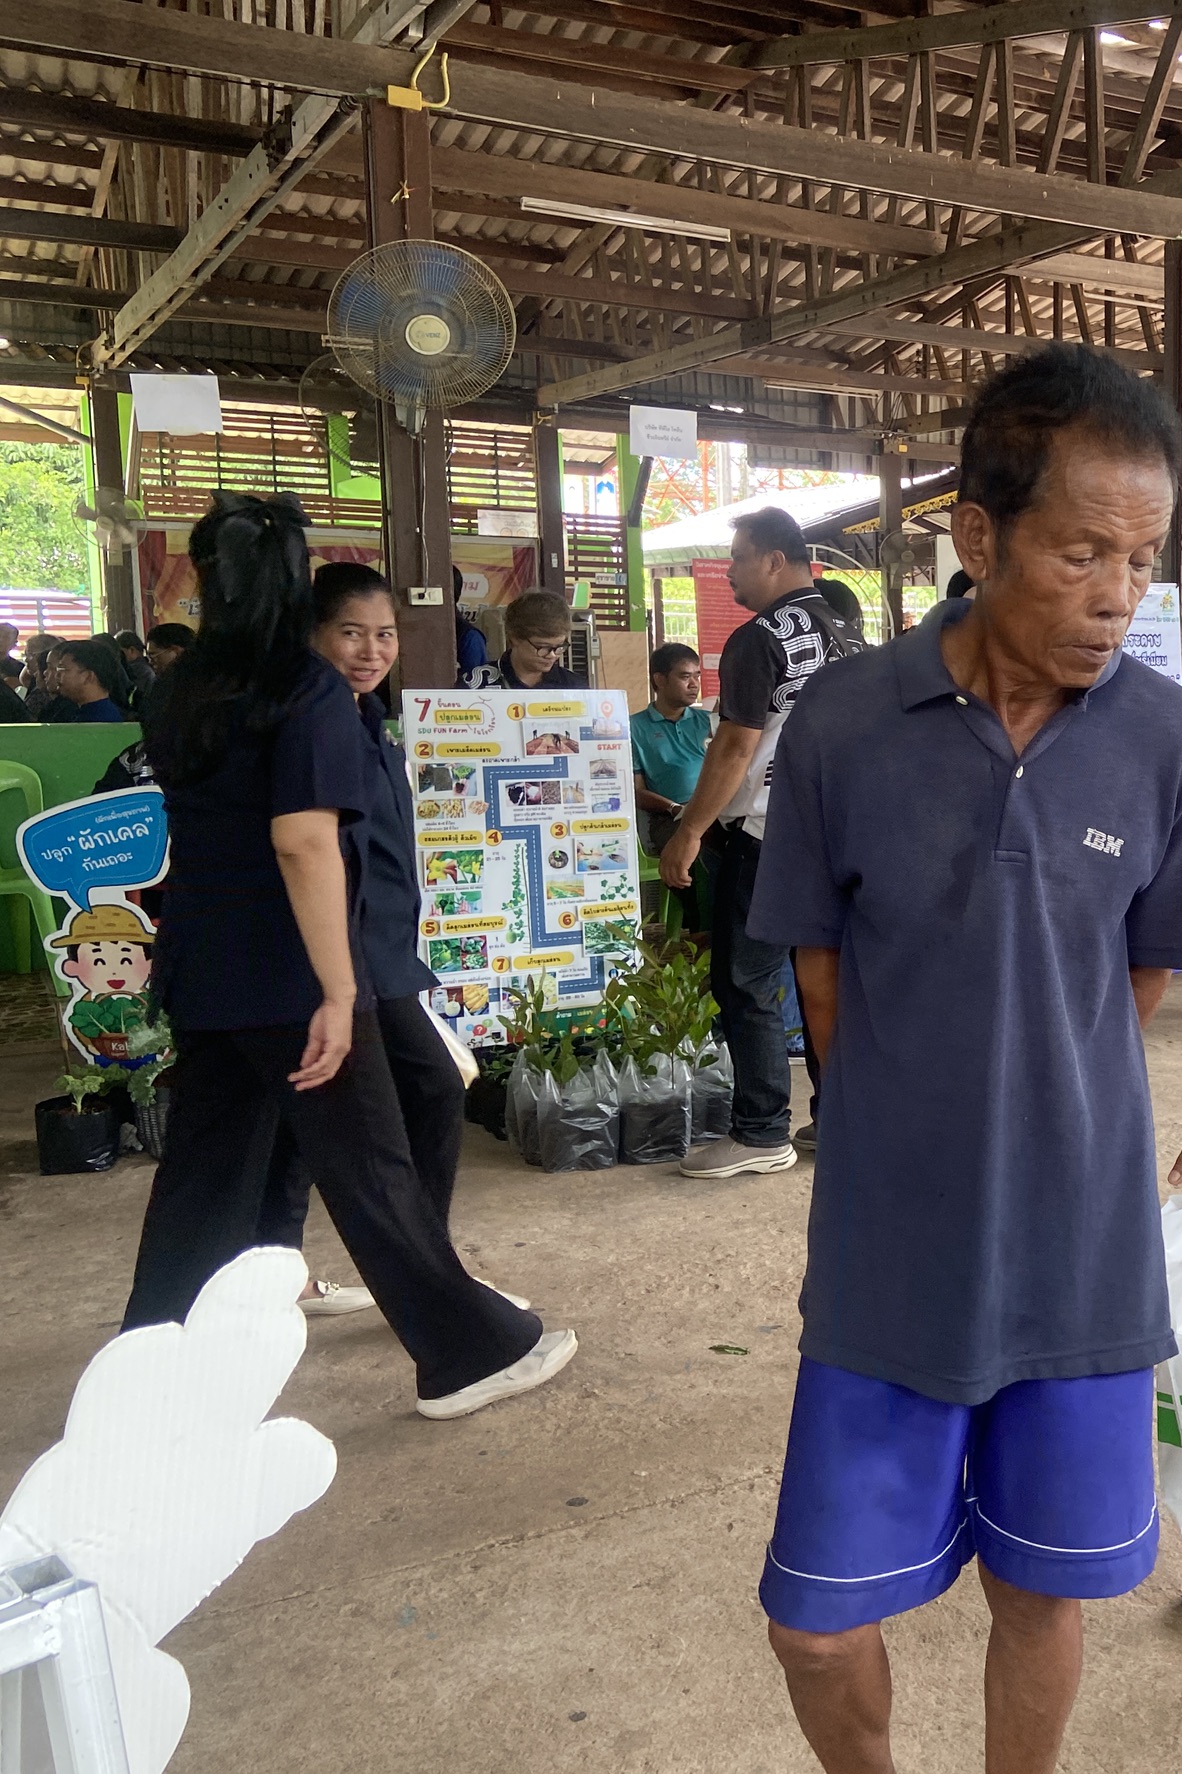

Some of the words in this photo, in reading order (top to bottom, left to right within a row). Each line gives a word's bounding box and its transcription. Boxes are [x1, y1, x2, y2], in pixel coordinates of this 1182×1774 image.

[414, 698, 431, 722] 7
[513, 706, 520, 718] 1
[419, 744, 430, 756] 2
[554, 824, 564, 836] 3
[488, 831, 499, 843] 4
[1083, 828, 1125, 857] IBM
[41, 846, 72, 862] ปลูก
[82, 852, 133, 871] กันเถอะ
[562, 914, 572, 926] 6
[425, 922, 436, 934] 5
[496, 958, 505, 970] 7
